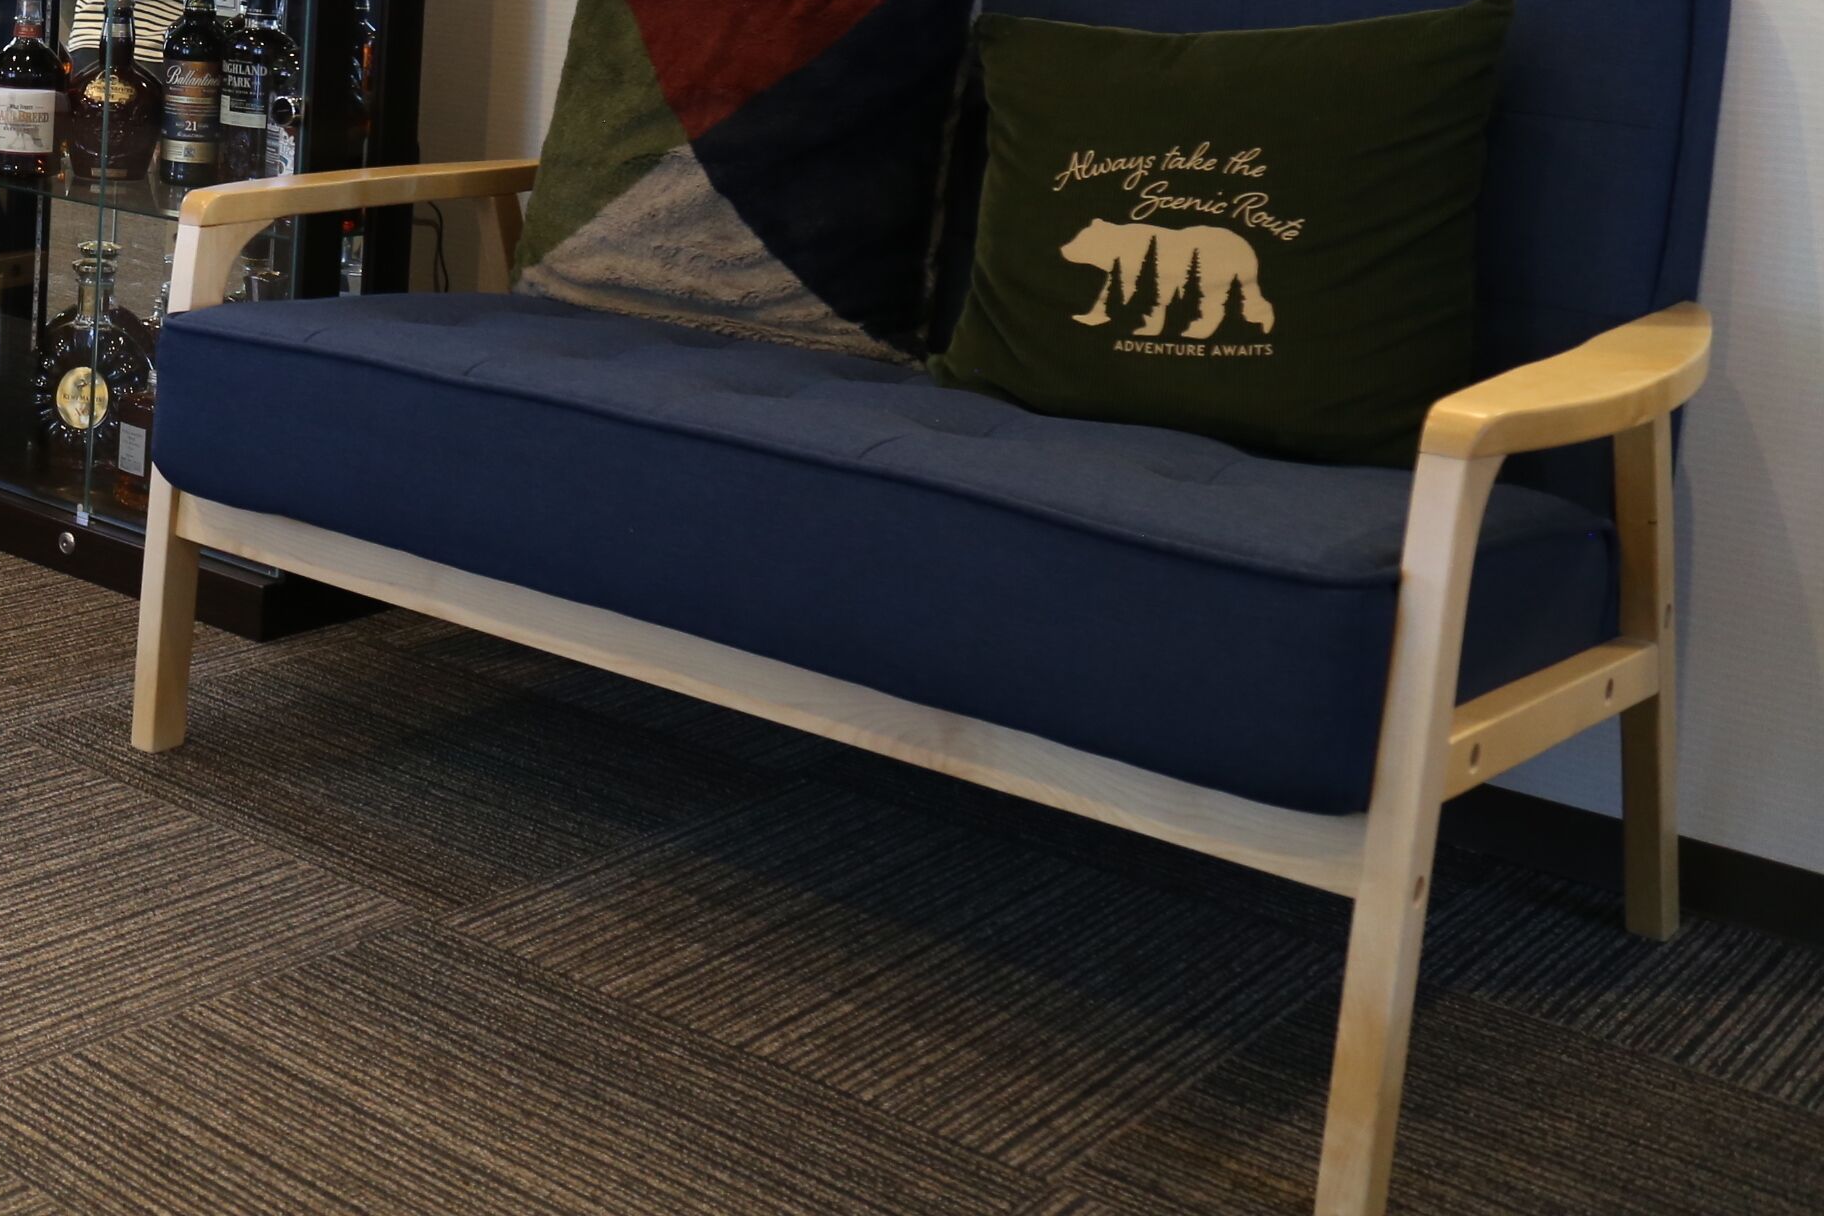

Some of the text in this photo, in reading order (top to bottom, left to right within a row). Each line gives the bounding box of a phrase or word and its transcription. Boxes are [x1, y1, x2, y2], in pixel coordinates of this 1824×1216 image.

[228, 74, 251, 88] PARK
[185, 120, 197, 131] 21
[1053, 141, 1267, 191] Always take the
[1131, 181, 1306, 241] Scenic Route
[1113, 339, 1274, 357] ADVENTURE AWAITS
